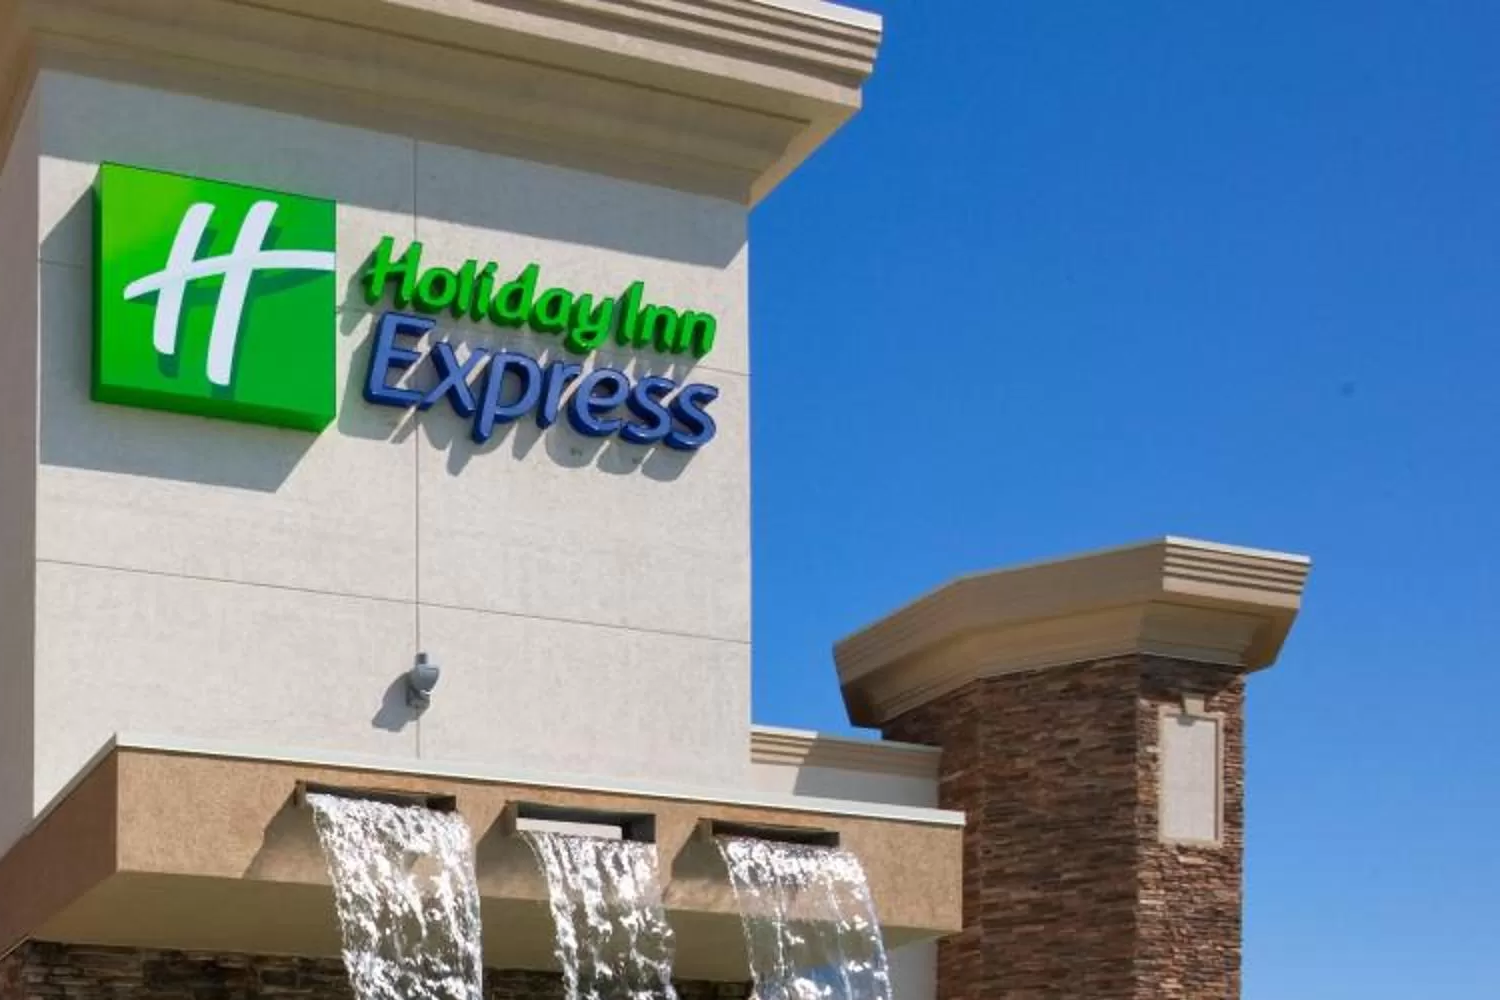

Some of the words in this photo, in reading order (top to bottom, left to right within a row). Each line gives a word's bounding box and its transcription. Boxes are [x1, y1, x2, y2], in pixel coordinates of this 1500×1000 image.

[124, 200, 335, 386] H
[363, 236, 611, 353] Holiday
[613, 280, 716, 357] Inn
[364, 311, 719, 449] Express
